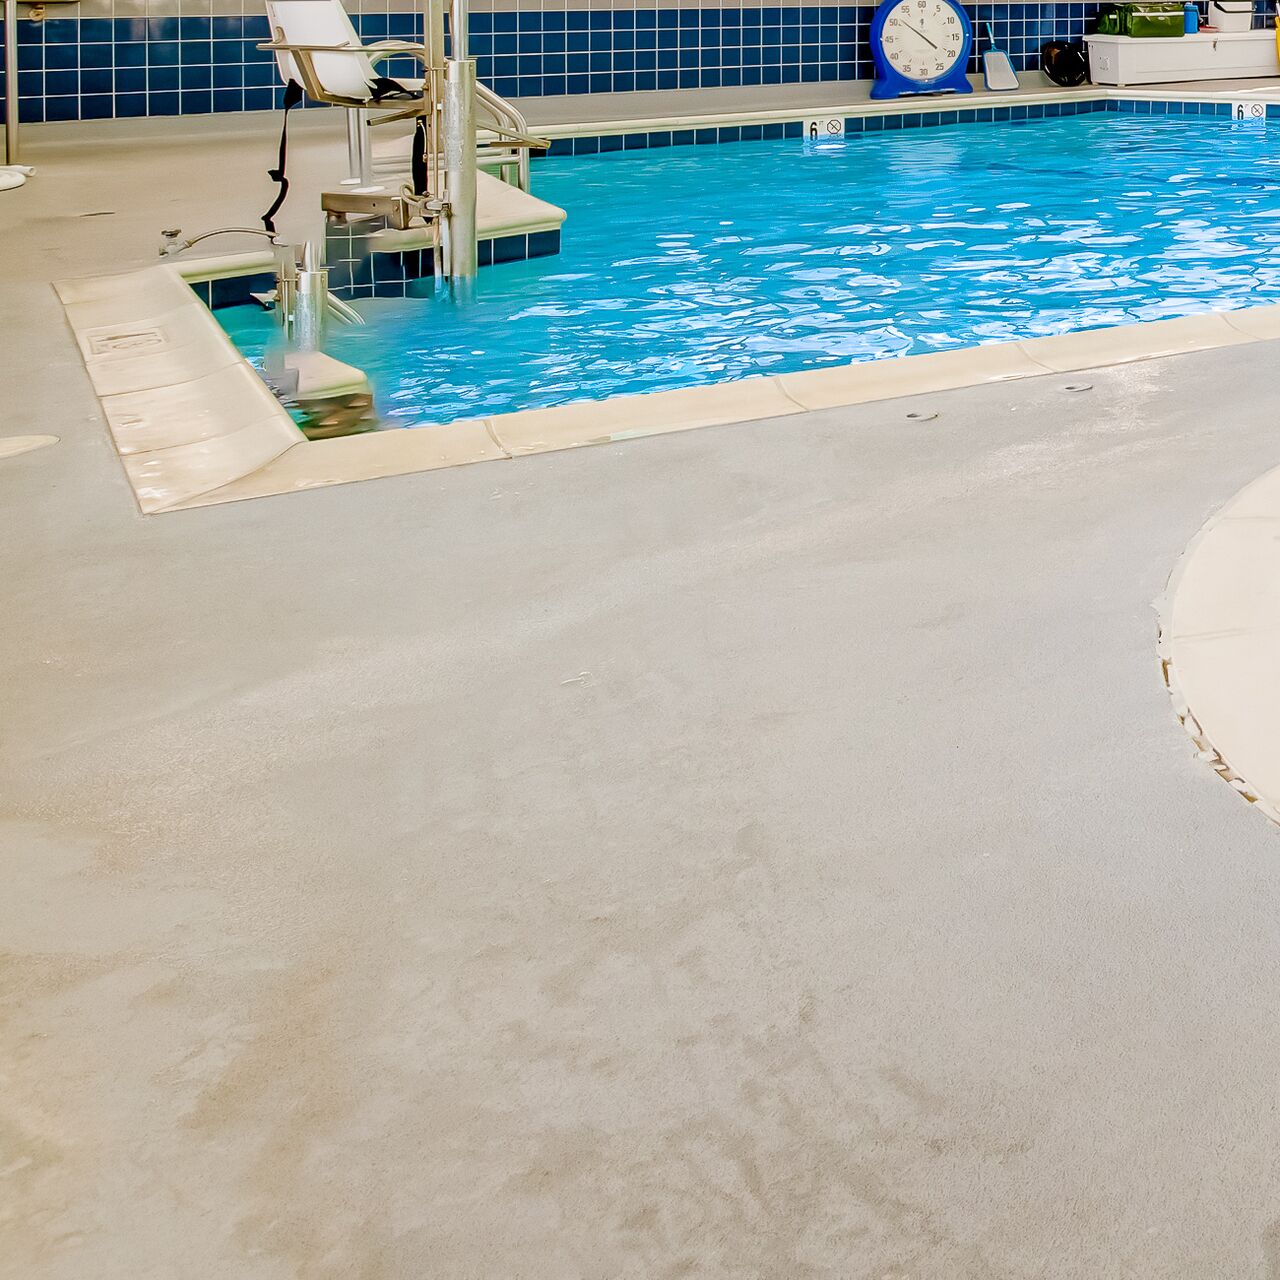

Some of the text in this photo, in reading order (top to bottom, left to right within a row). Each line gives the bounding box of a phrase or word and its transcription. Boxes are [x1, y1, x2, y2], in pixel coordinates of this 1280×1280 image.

[951, 33, 960, 41] 15
[903, 65, 911, 73] 35
[936, 63, 944, 71] 25
[1237, 104, 1244, 120] 6
[810, 121, 818, 140] 6
